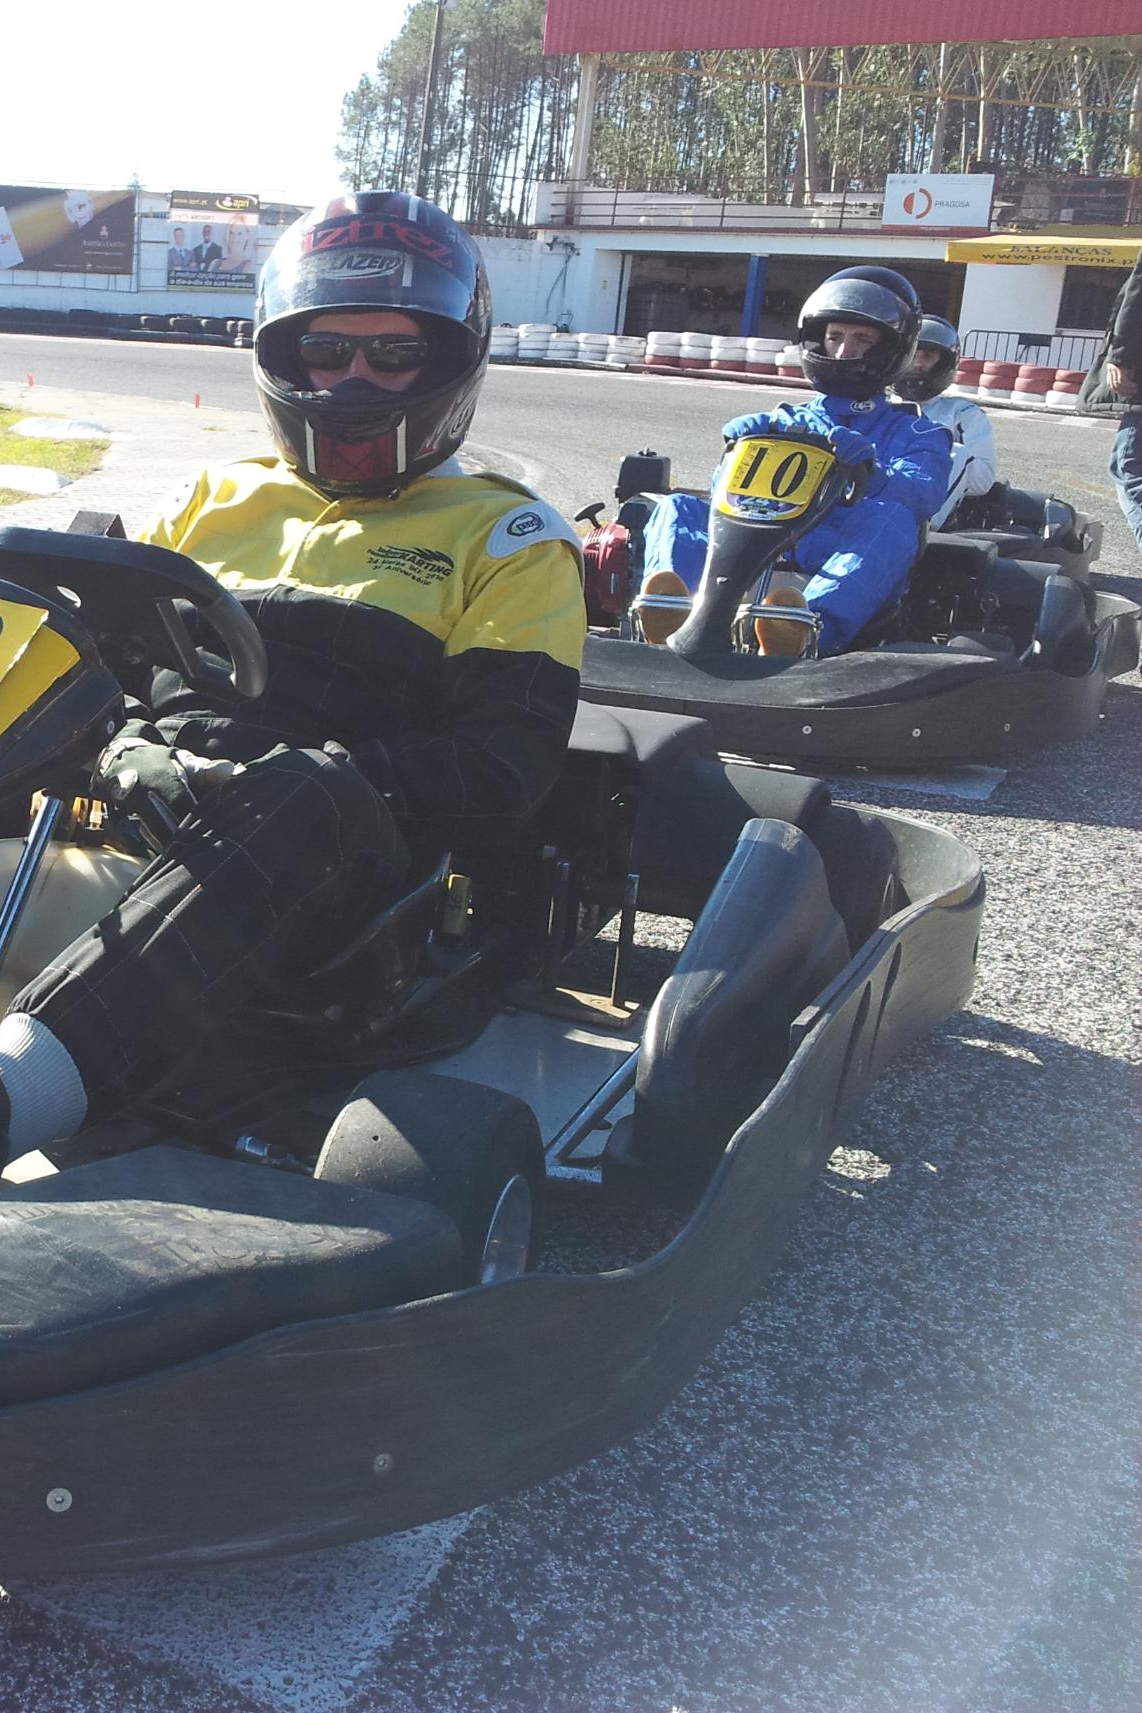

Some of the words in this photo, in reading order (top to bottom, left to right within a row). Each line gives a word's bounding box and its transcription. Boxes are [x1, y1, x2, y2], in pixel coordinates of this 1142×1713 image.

[934, 200, 970, 208] PRAGOSA
[739, 447, 808, 498] 10
[401, 552, 453, 576] KARTING
